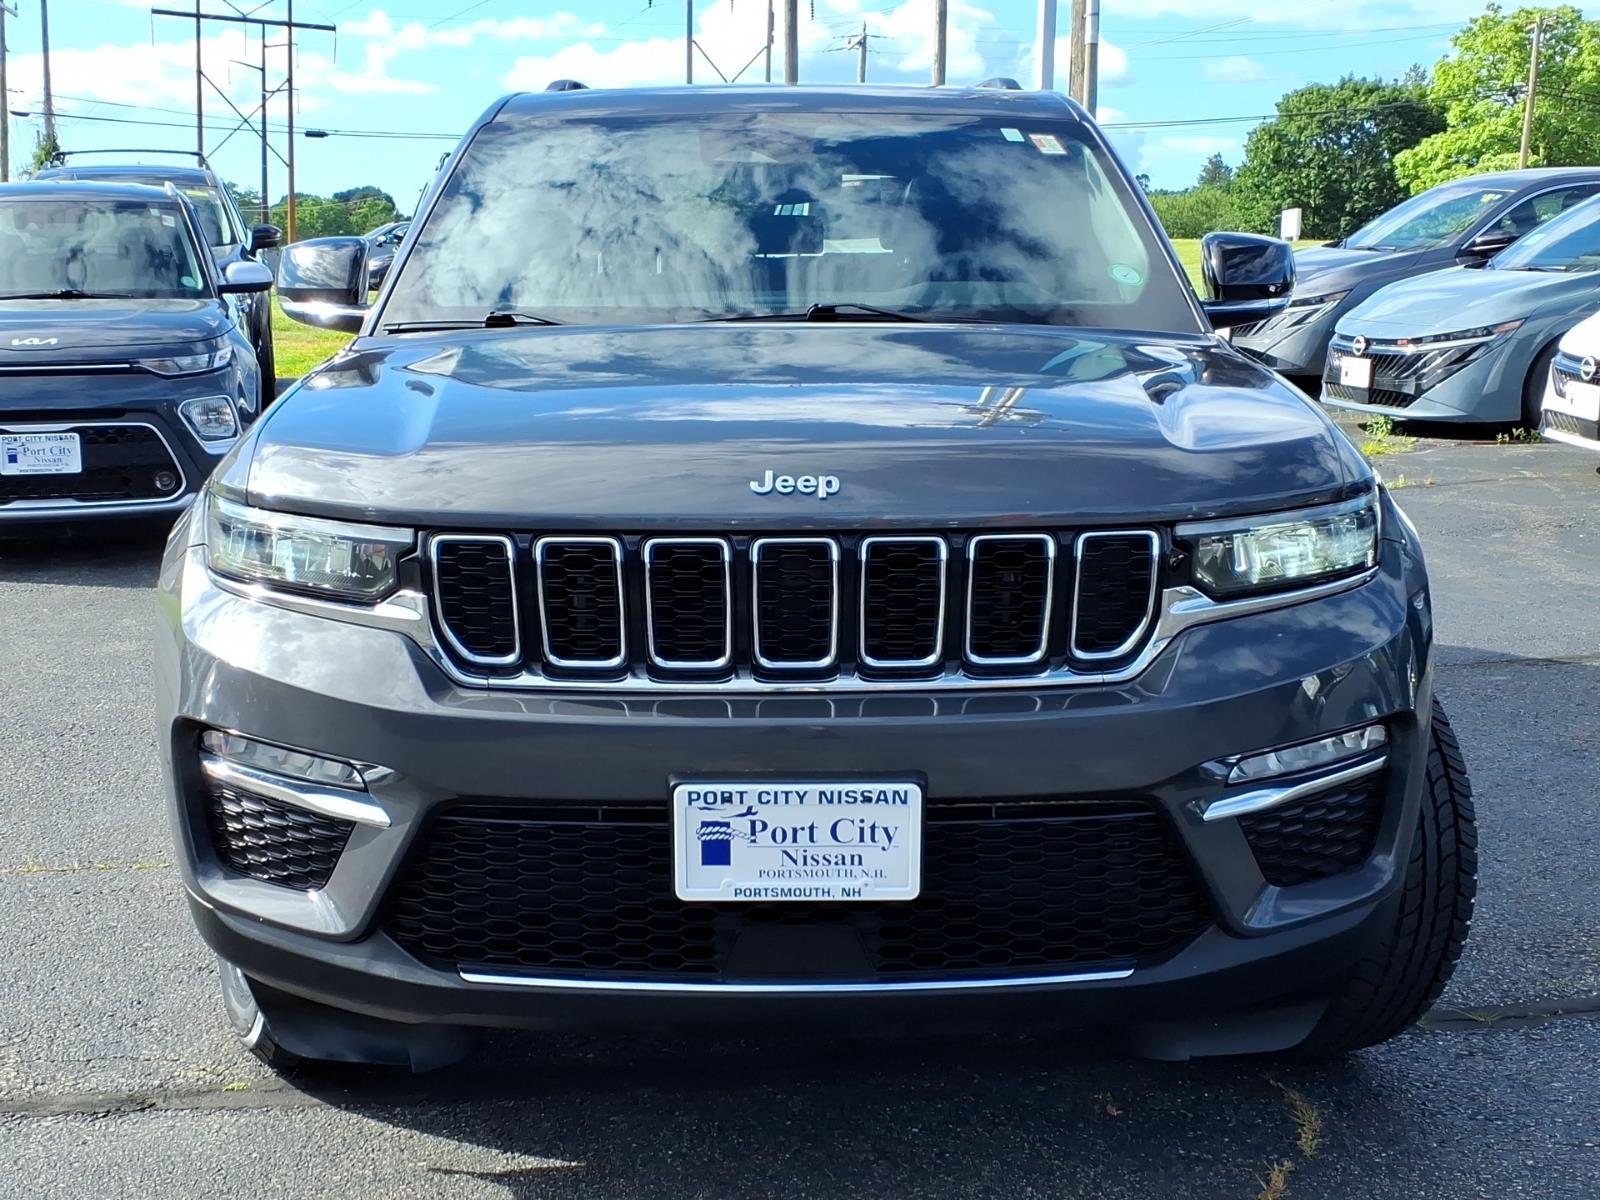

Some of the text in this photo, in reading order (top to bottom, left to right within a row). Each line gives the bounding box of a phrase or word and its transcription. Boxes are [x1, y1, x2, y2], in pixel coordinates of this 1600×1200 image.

[23, 445, 73, 457] Port City
[34, 456, 62, 464] Nissan
[749, 470, 840, 499] Jeep
[687, 789, 908, 806] PORT CITY NISSAN
[747, 817, 899, 851] Port City
[781, 849, 864, 867] Nissan
[758, 868, 887, 879] PORTSMOUTH, N.H.
[734, 887, 862, 899] PORTSMOUTH, NH
